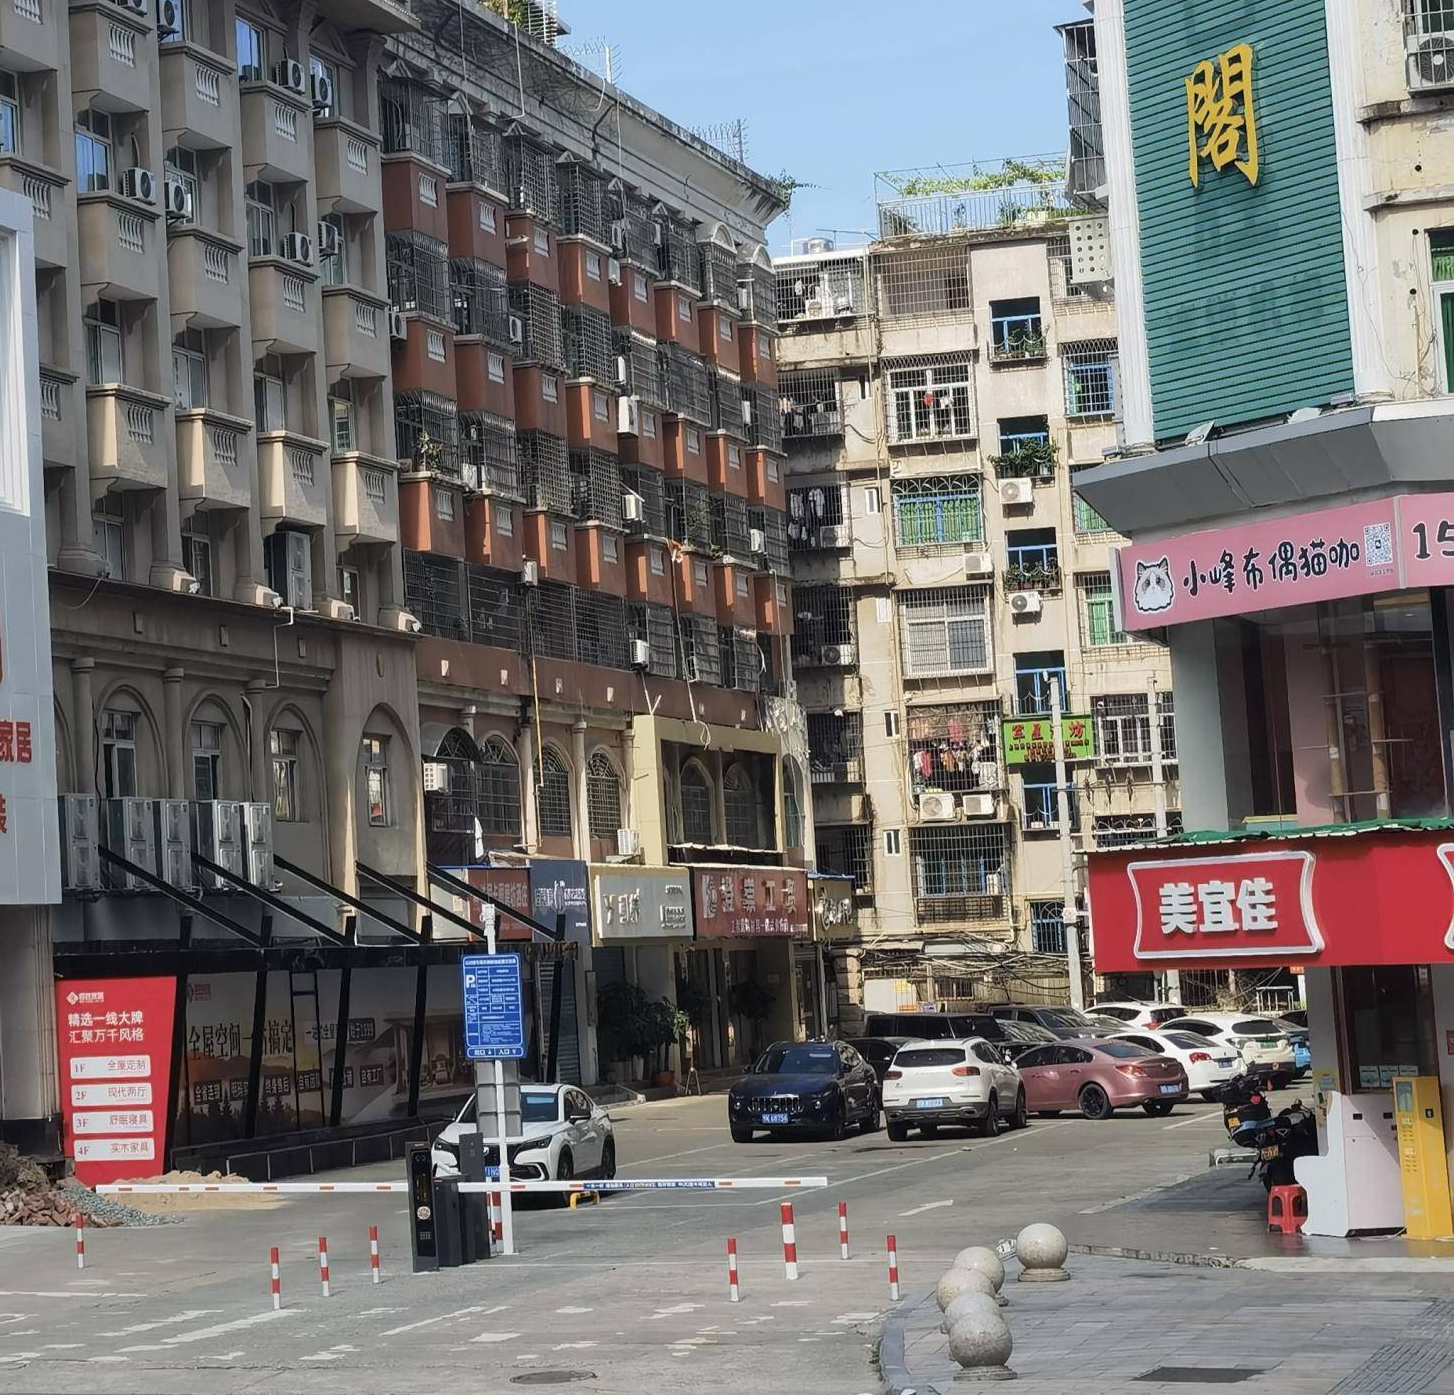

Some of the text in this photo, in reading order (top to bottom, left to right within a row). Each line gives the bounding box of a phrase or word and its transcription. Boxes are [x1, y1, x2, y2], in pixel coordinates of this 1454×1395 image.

[1182, 537, 1360, 597] 小峰布偶猫咖
[1158, 877, 1279, 935] 美宜佳
[68, 1010, 144, 1027] 精选一线大牌
[69, 1028, 144, 1044] 汇聚万千风格
[75, 1063, 85, 1073] 1F
[76, 1090, 87, 1100] 2F
[77, 1118, 88, 1128] 3F
[78, 1145, 90, 1155] 4F
